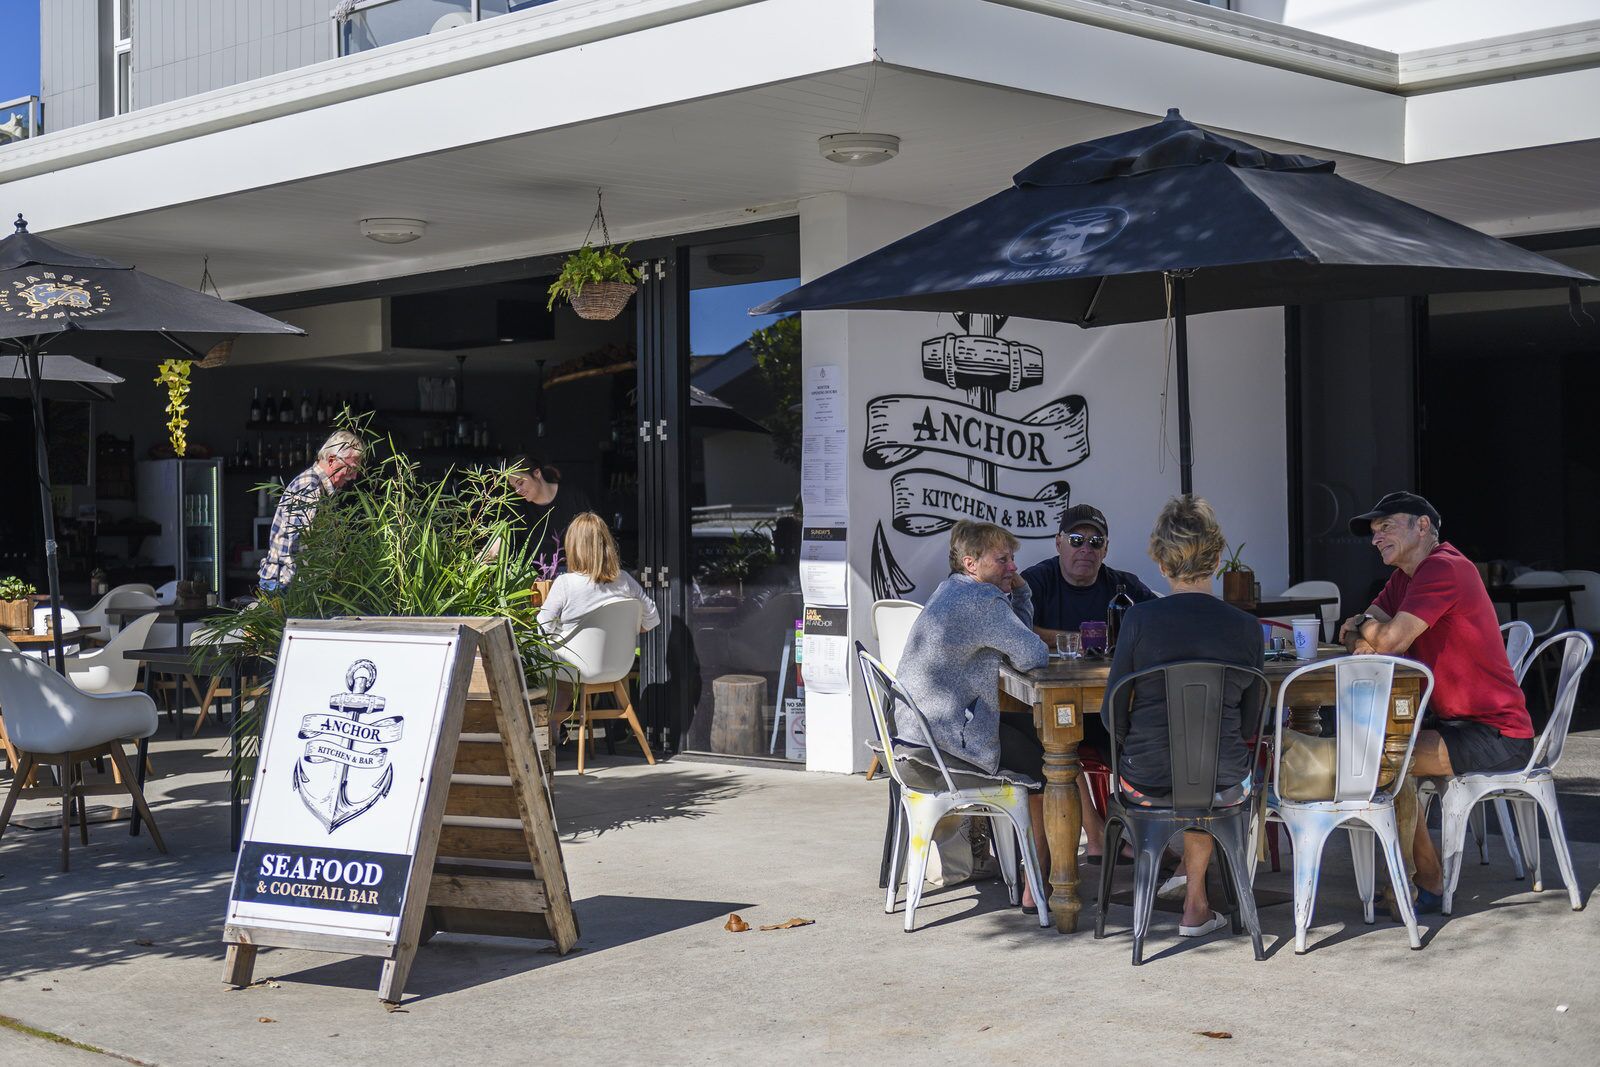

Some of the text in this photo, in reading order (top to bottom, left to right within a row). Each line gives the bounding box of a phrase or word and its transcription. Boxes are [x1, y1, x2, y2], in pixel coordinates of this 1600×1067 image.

[12, 272, 90, 289] JANSZ
[1036, 264, 1088, 277] COFFEE
[17, 307, 106, 319] TASMANIA
[912, 405, 1052, 466] ANCHOR
[922, 488, 1048, 528] KITCHEN & BAR
[320, 718, 382, 742] ANCHOR
[317, 746, 350, 761] KITCHEN
[358, 756, 374, 765] BAR
[259, 853, 383, 886] SEAFOOD
[256, 881, 379, 905] & COCKTAIL BAR
